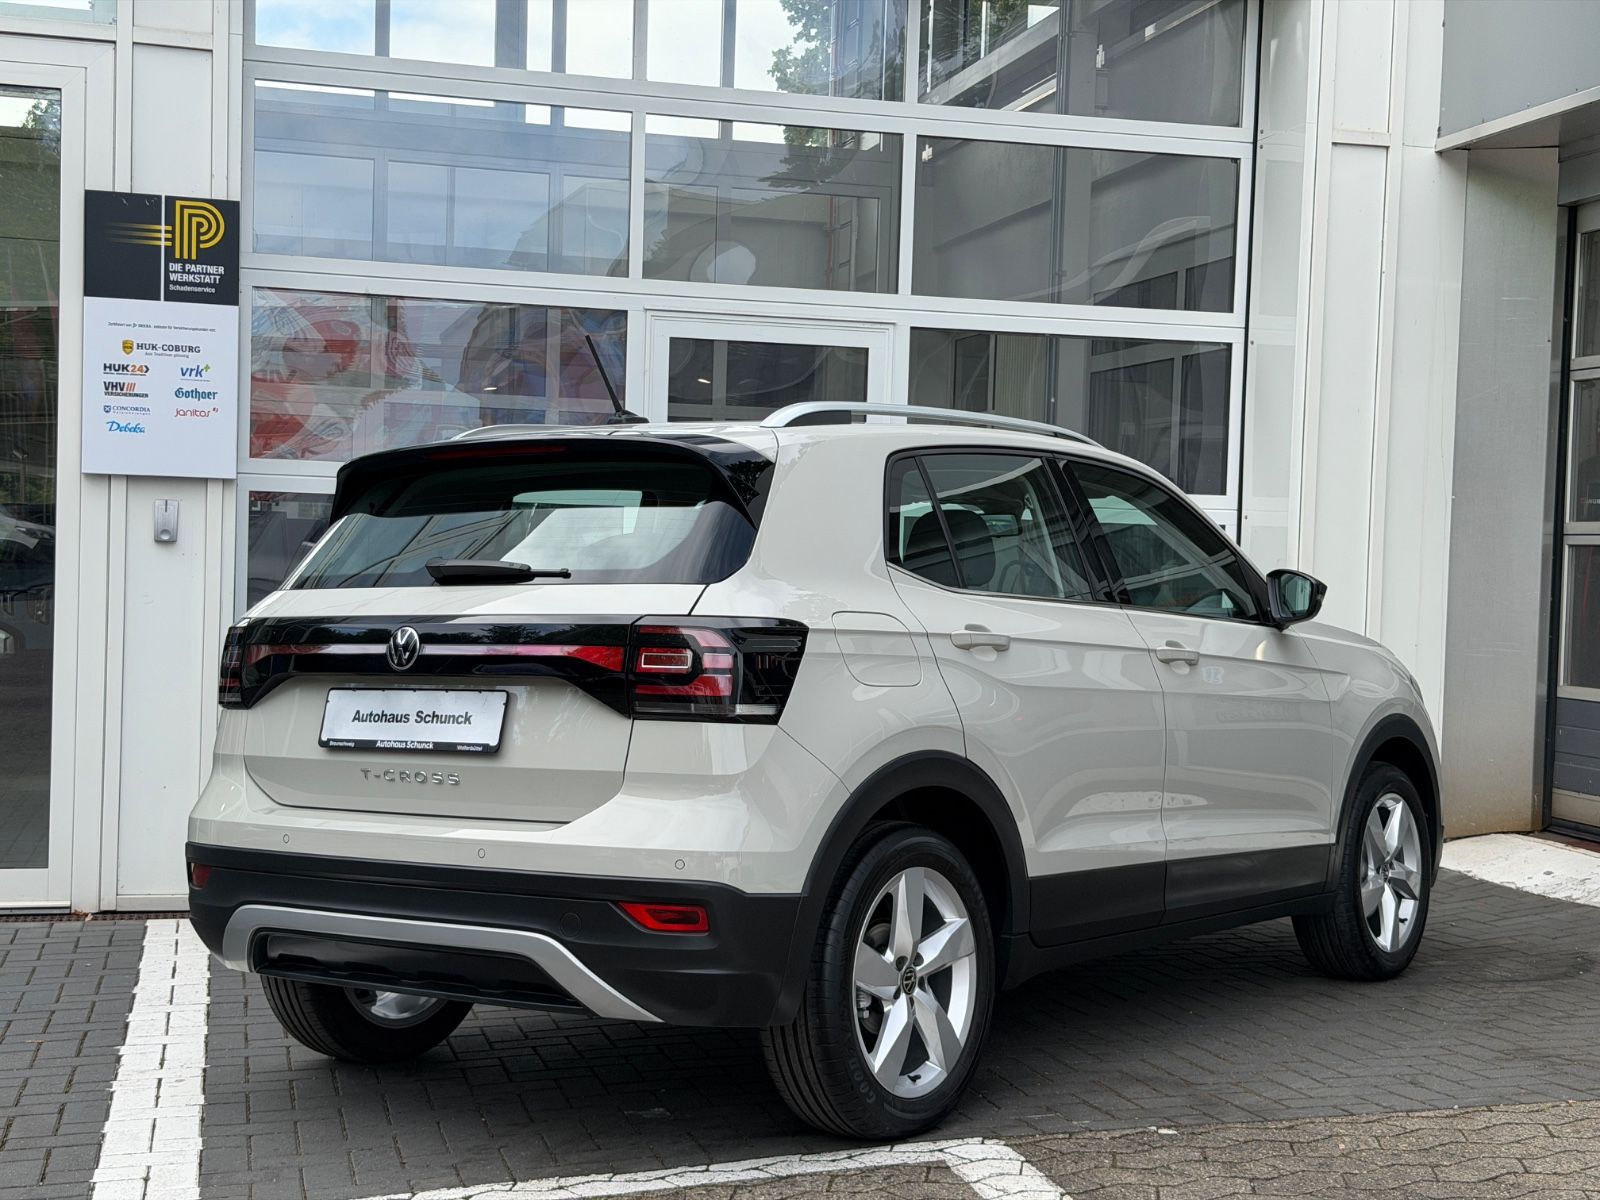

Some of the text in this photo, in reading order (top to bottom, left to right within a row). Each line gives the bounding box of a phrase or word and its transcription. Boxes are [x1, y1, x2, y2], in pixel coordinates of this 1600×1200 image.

[169, 263, 225, 275] DIE PARTNER
[169, 273, 221, 284] WERKSTATT
[169, 284, 216, 293] Schadenservice
[136, 342, 201, 354] HUK-COBURG
[103, 363, 145, 373] HUK24
[174, 387, 219, 401] Gothaer
[106, 420, 145, 434] Debeka
[352, 709, 473, 725] Autohaus Schunck
[375, 740, 406, 749] Autohaus
[406, 741, 434, 750] Schunck
[360, 767, 462, 785] T-CROSS
